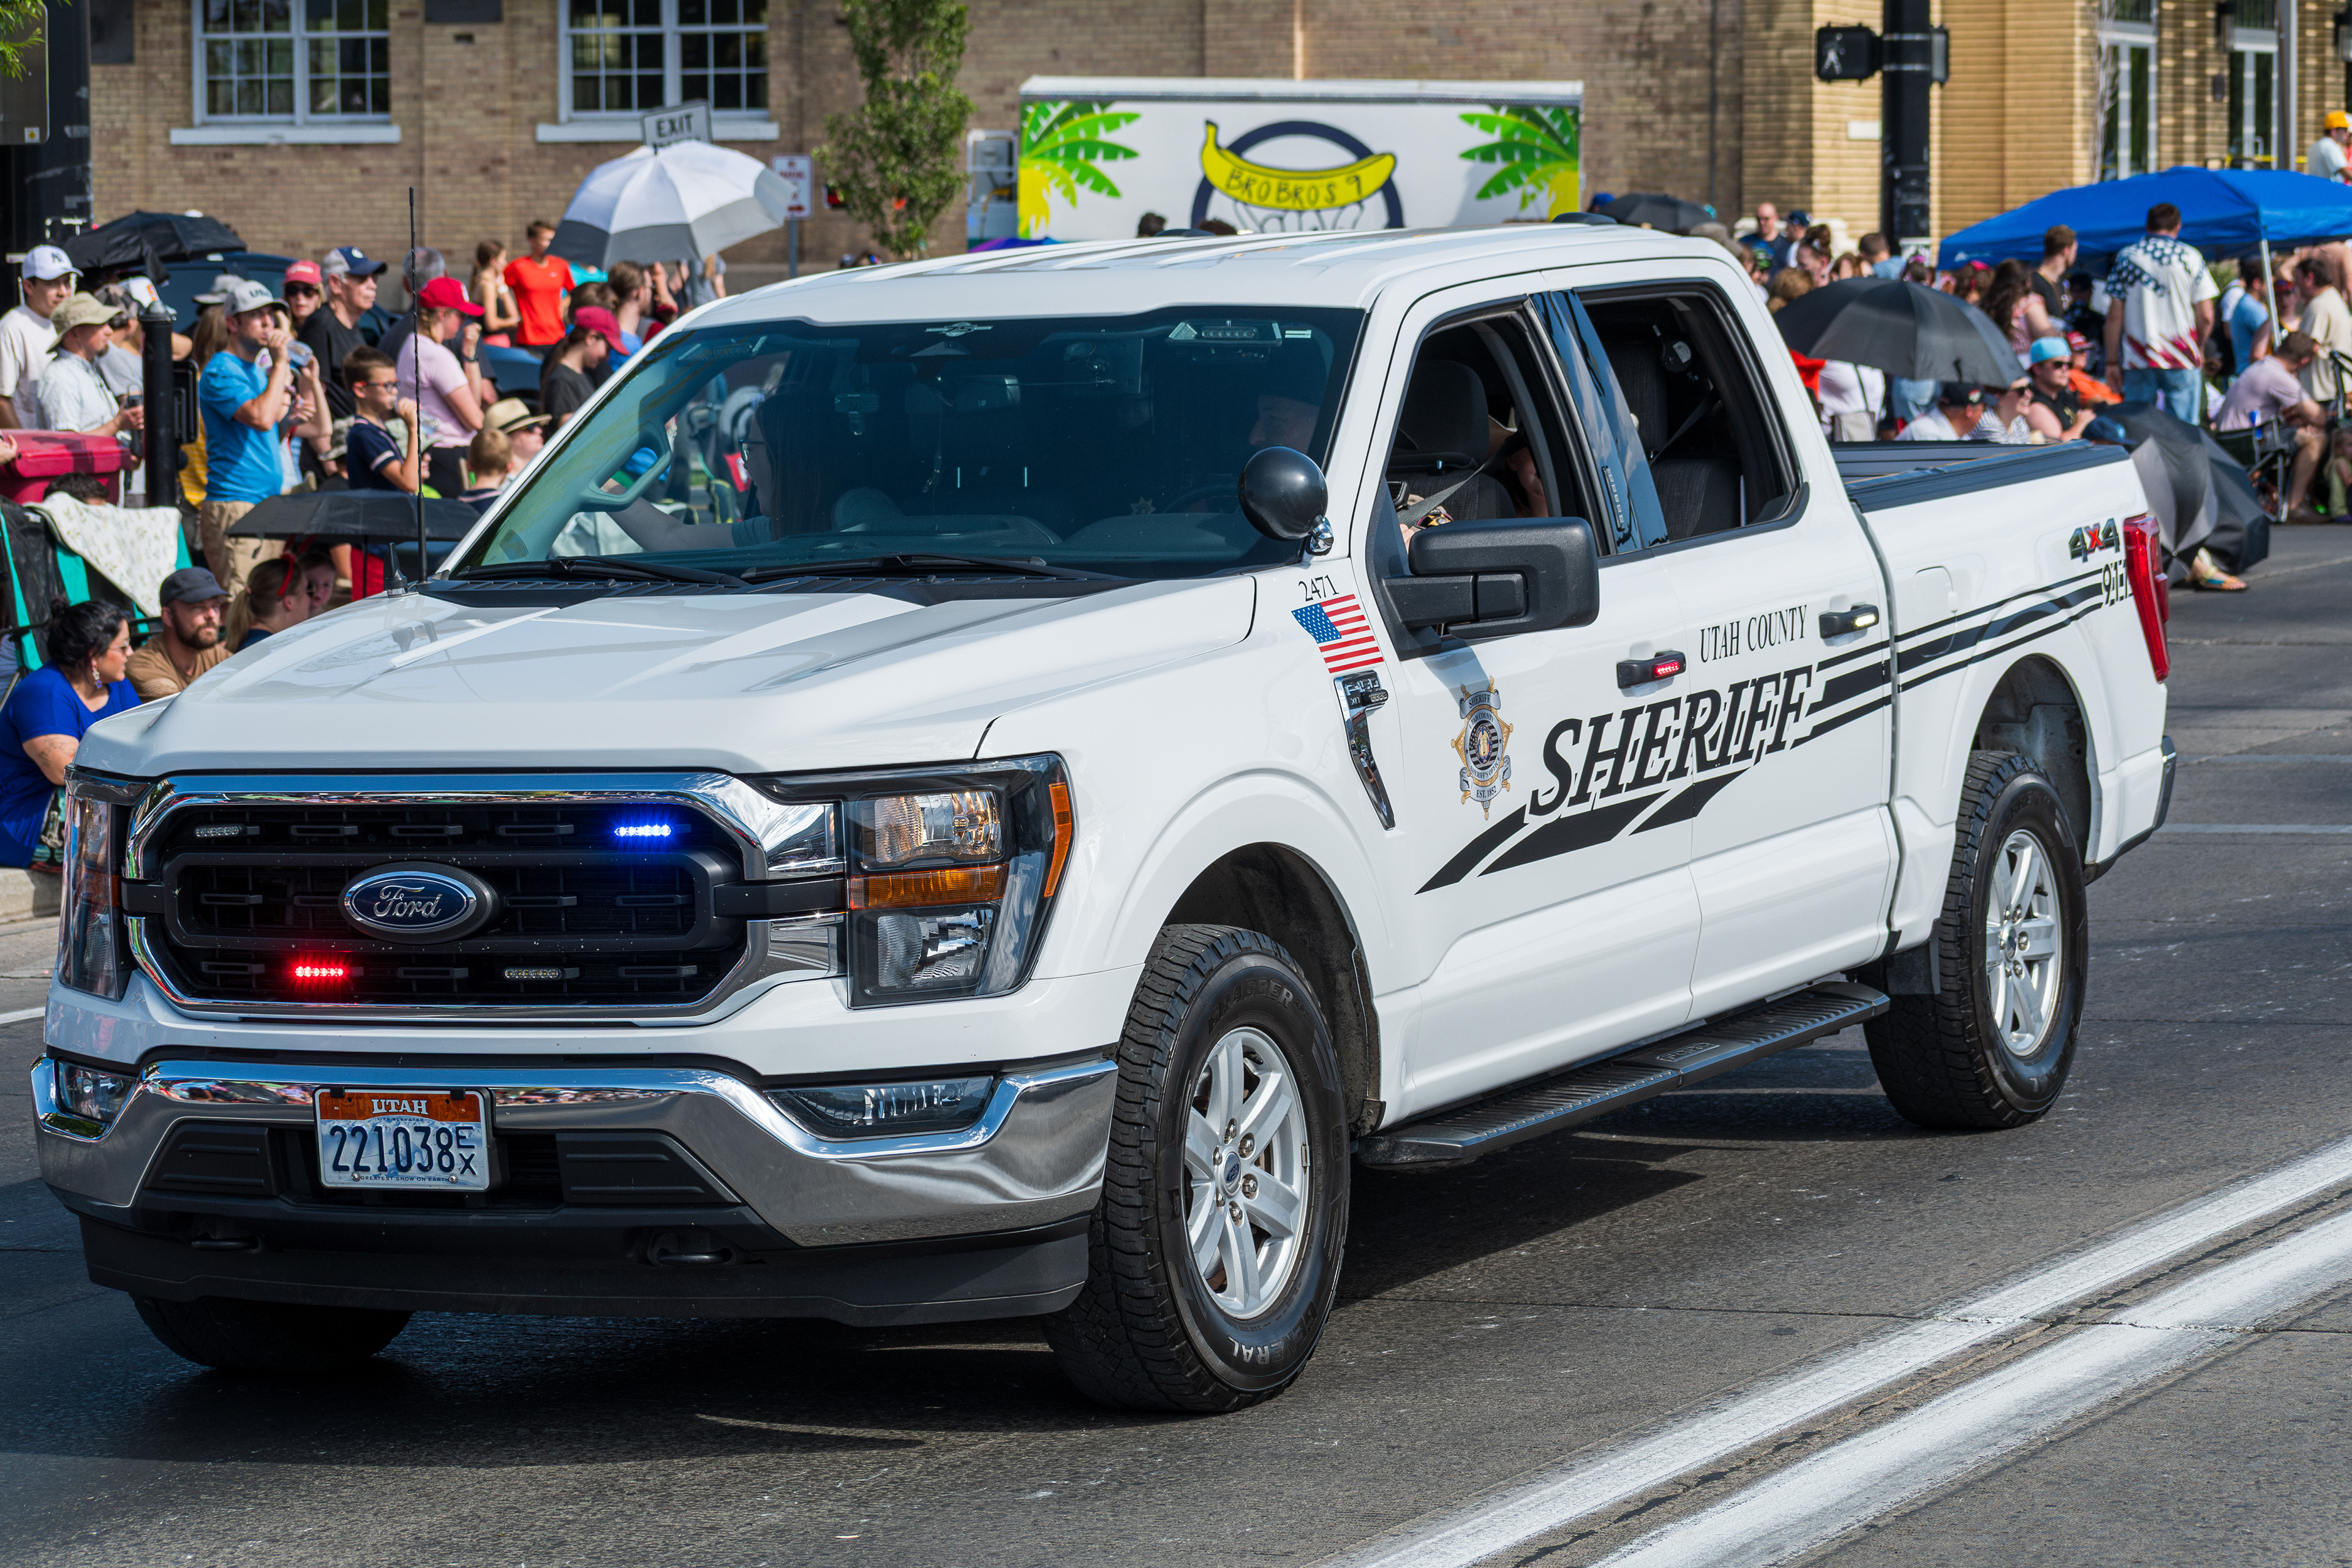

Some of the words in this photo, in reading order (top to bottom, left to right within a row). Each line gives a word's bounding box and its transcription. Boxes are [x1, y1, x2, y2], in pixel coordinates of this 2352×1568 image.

[656, 113, 693, 137] EXIT
[1298, 575, 1340, 601] 2471
[1700, 620, 1741, 663] UTAH
[1747, 605, 1807, 652] COUNTY
[1468, 693, 1491, 709] SHERIFF
[1469, 715, 1479, 729] UTAH
[1478, 712, 1494, 723] COUNTY
[1528, 665, 1813, 816] SHERIFF
[1488, 755, 1501, 775] OFFICE
[1476, 790, 1487, 798] EST.
[1487, 785, 1497, 797] 1852
[373, 885, 443, 918] Ford
[1208, 978, 1294, 1035] GRABBER
[371, 1099, 429, 1115] UTAH
[330, 1125, 456, 1173] 221038
[1227, 1300, 1317, 1365] GENERAL
